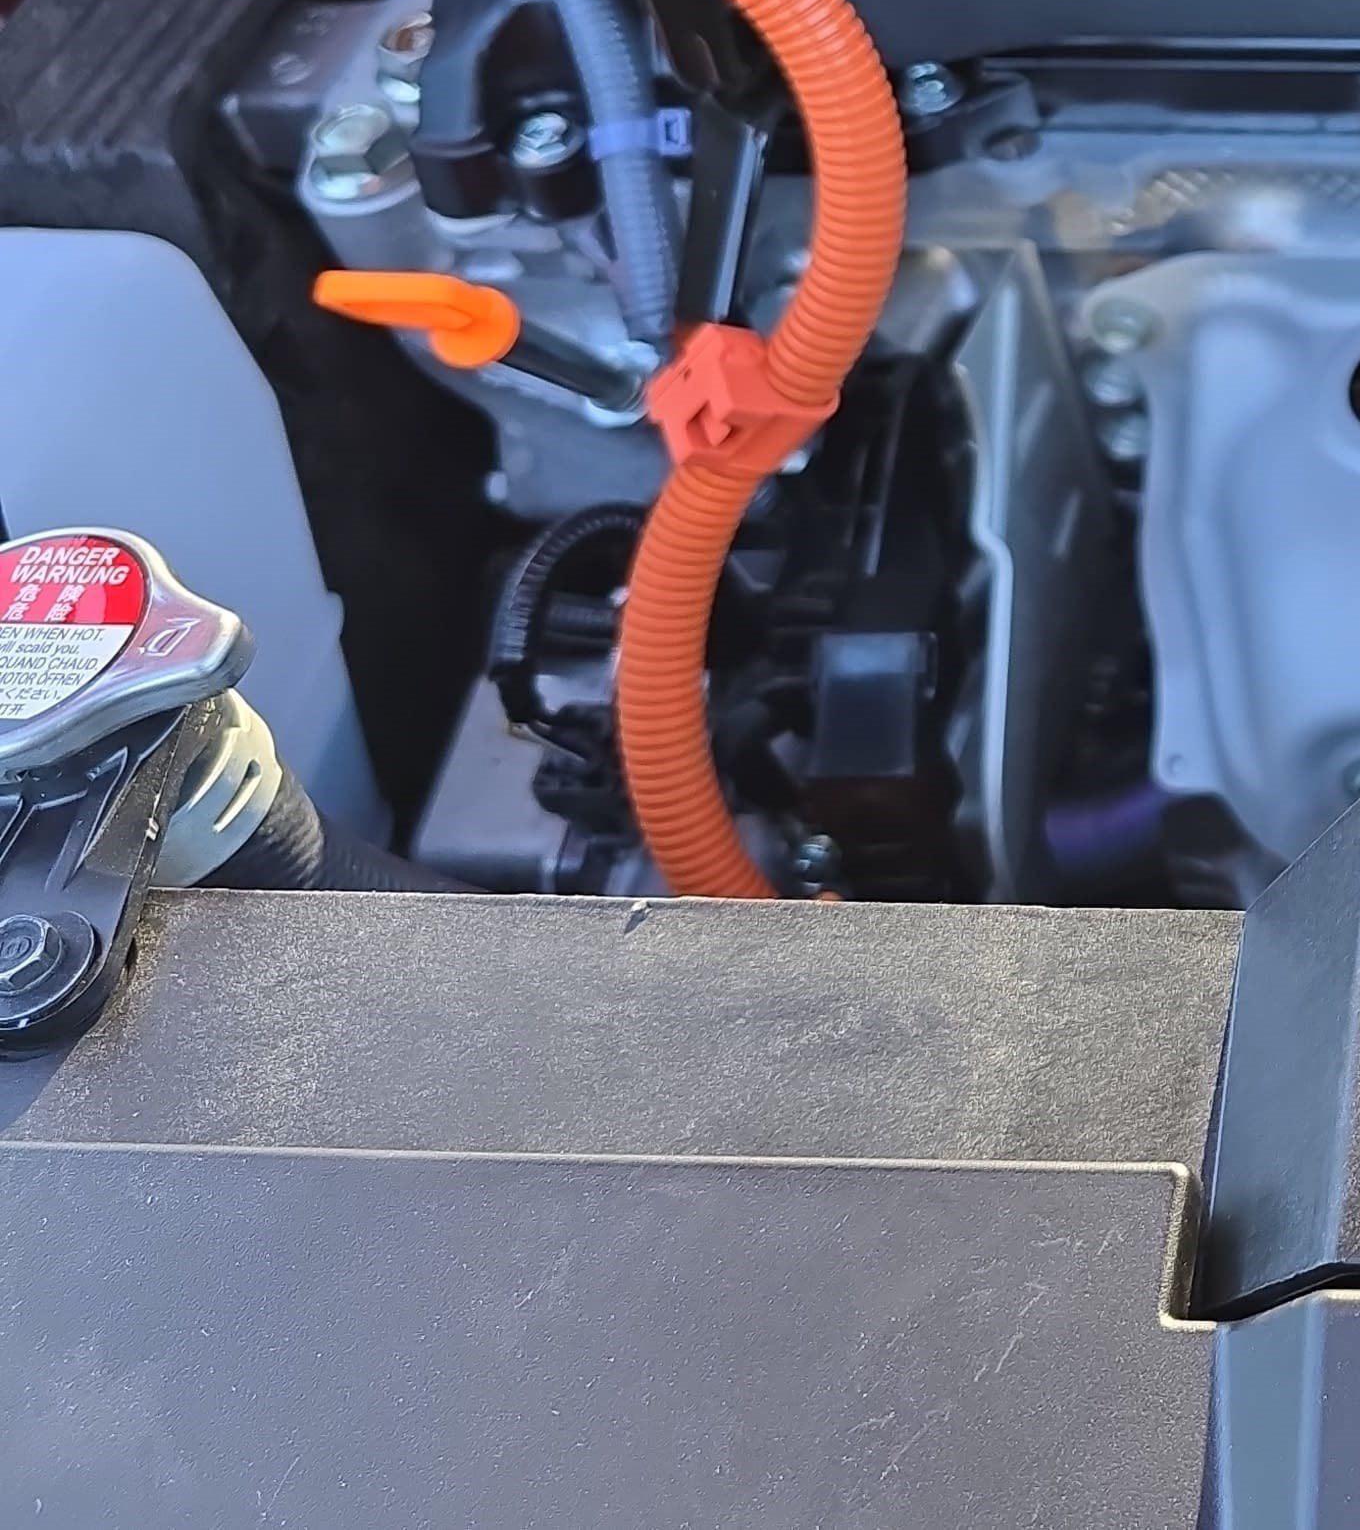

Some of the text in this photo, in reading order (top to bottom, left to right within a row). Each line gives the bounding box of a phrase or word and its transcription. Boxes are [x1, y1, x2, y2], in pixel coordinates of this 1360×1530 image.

[20, 546, 121, 566] DANGER
[10, 564, 130, 585] WARNUNG
[0, 626, 105, 641] EN WHEN HOT.
[15, 641, 54, 654] scald
[50, 644, 81, 658] you.
[0, 656, 99, 671] QUAND CHAUD.
